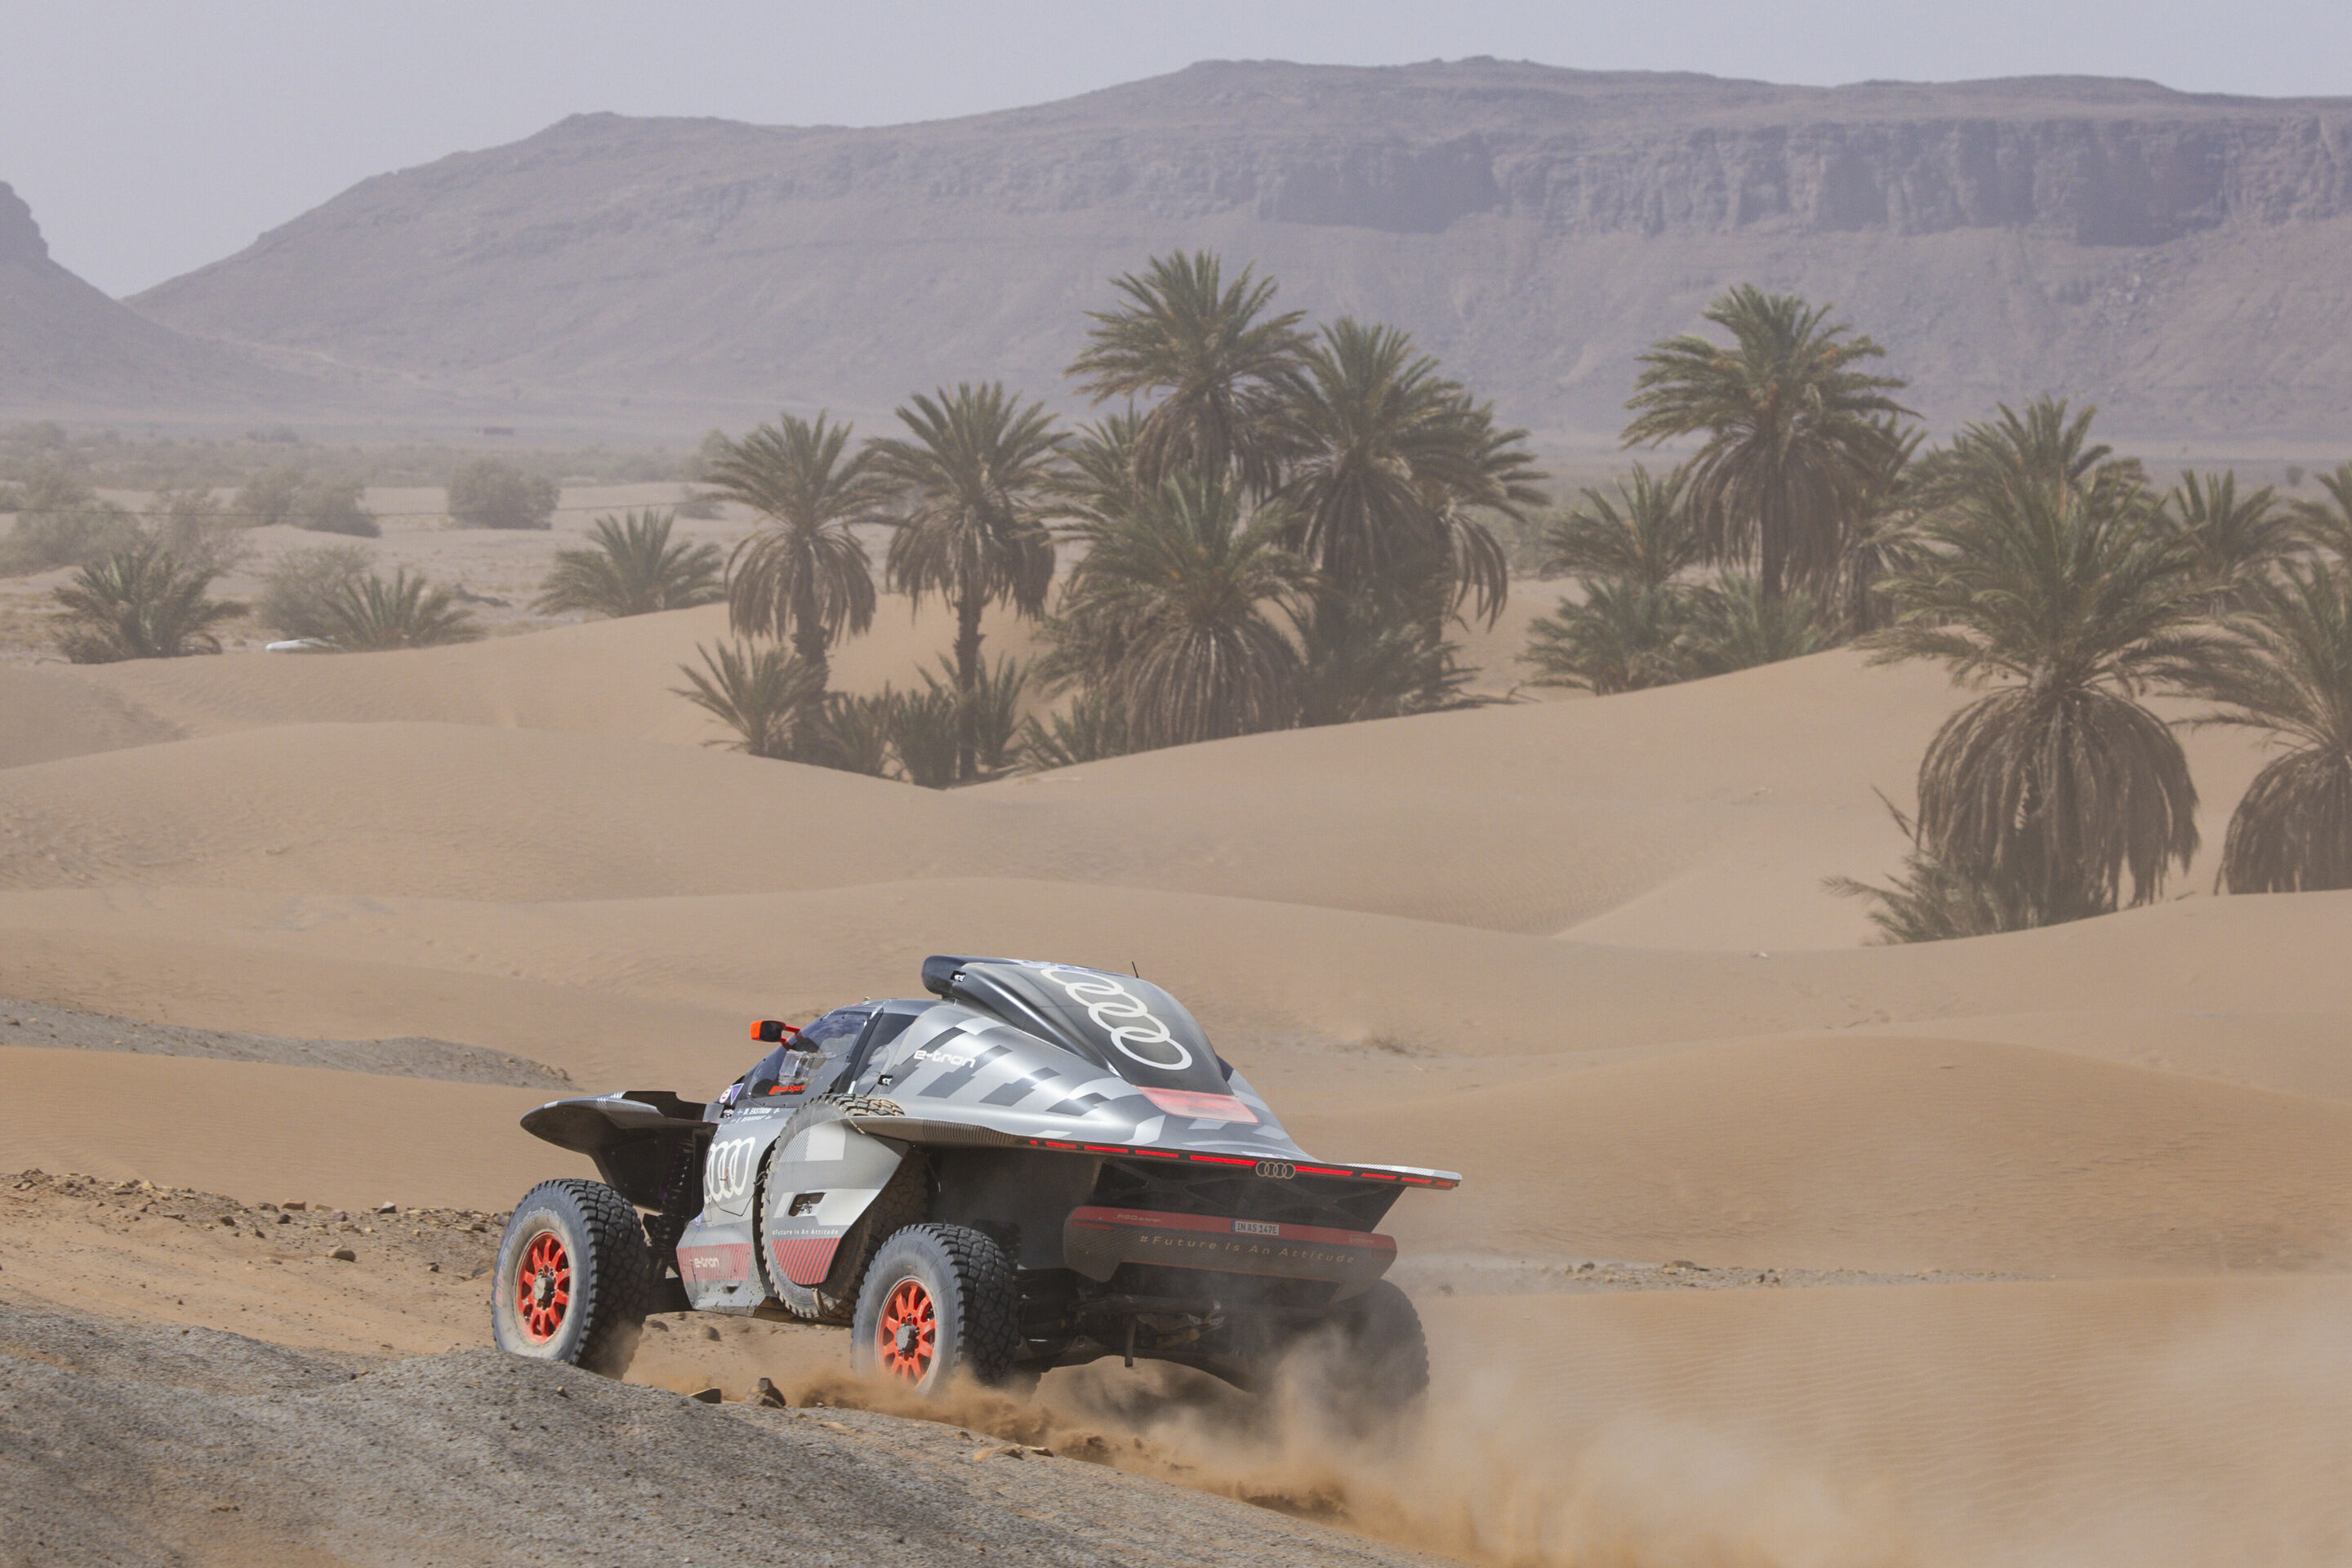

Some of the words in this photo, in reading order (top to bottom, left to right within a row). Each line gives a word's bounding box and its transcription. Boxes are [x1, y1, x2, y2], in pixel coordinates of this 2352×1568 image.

[913, 1049, 976, 1068] e-tron
[789, 1084, 804, 1094] Sport
[1236, 1222, 1246, 1232] IN
[1247, 1223, 1258, 1232] AS
[1139, 1235, 1217, 1250] #Future
[1225, 1242, 1241, 1252] Is
[1248, 1245, 1271, 1255] An
[1279, 1247, 1355, 1264] Attitude
